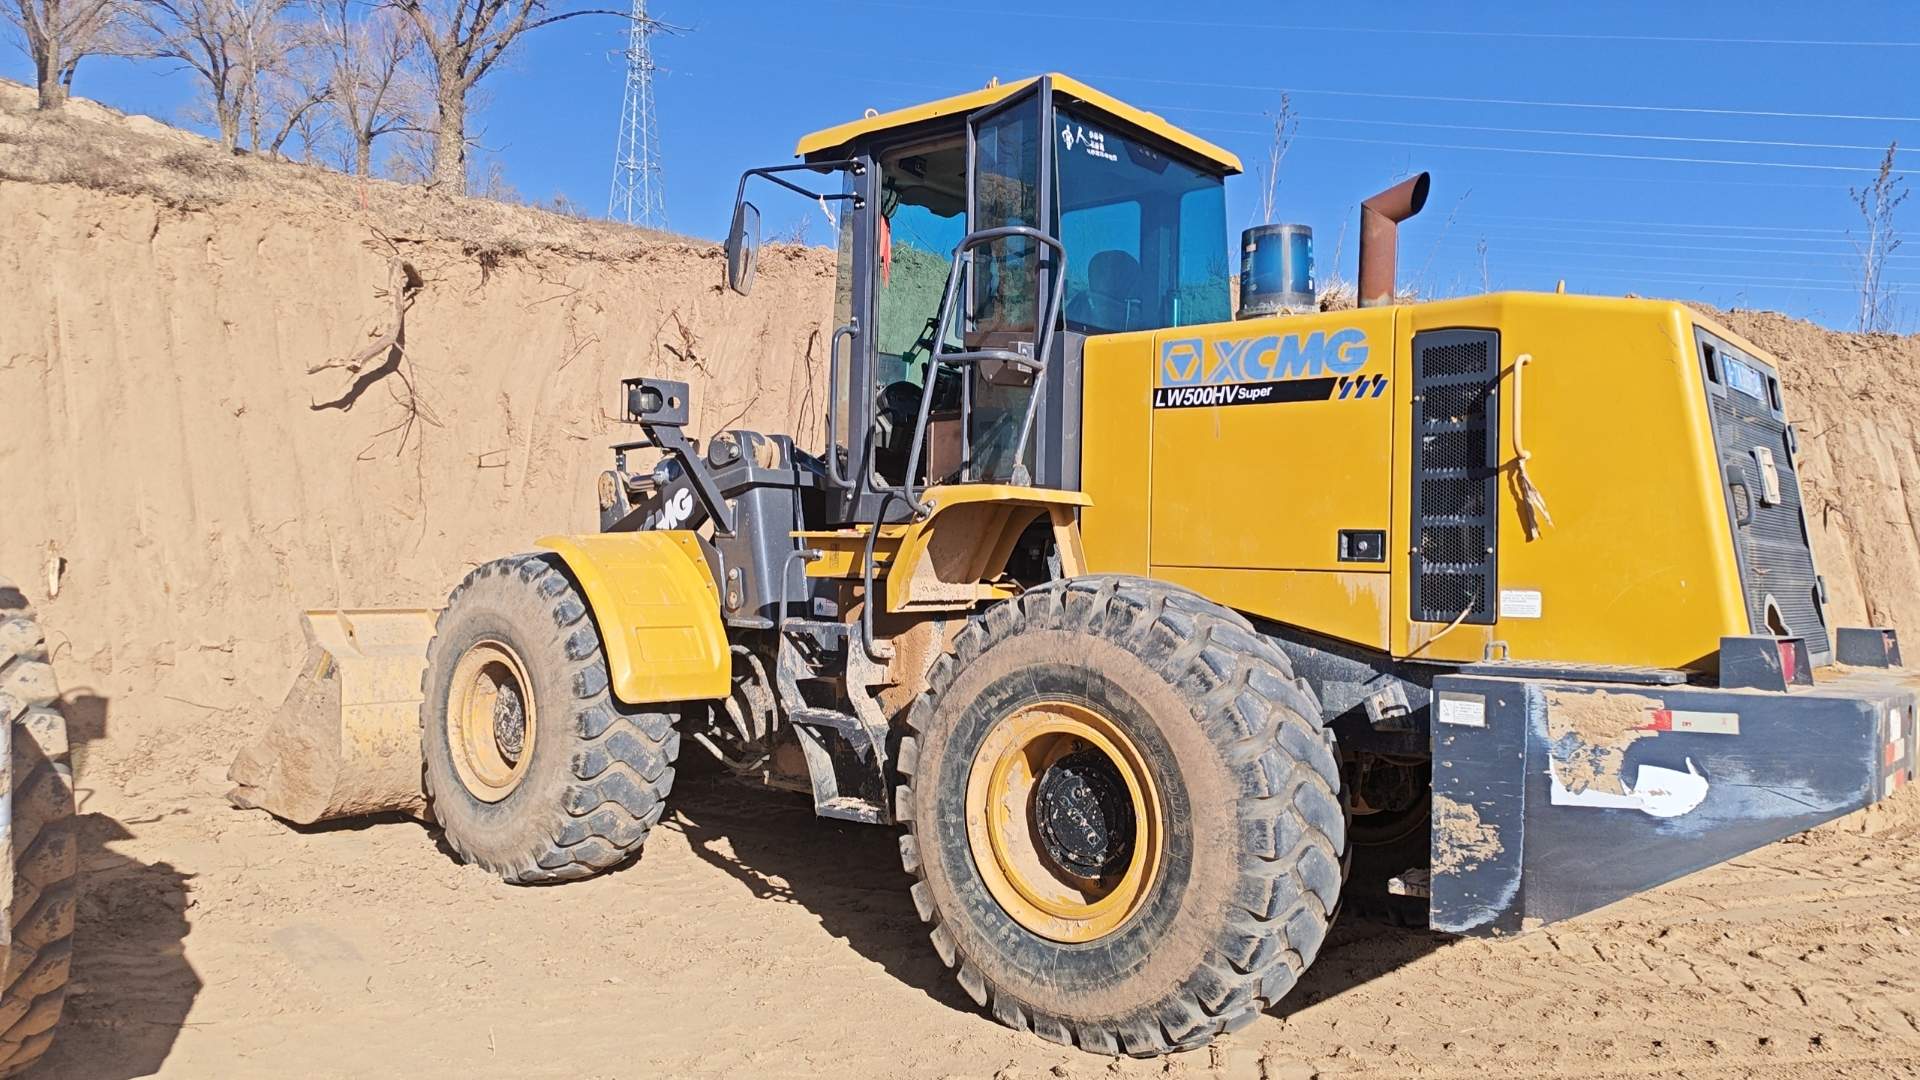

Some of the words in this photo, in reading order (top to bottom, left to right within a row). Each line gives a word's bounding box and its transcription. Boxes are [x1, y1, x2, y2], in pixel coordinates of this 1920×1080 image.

[1203, 327, 1369, 383] XCMG
[1155, 385, 1239, 408] LW500HV
[1238, 385, 1273, 401] Super
